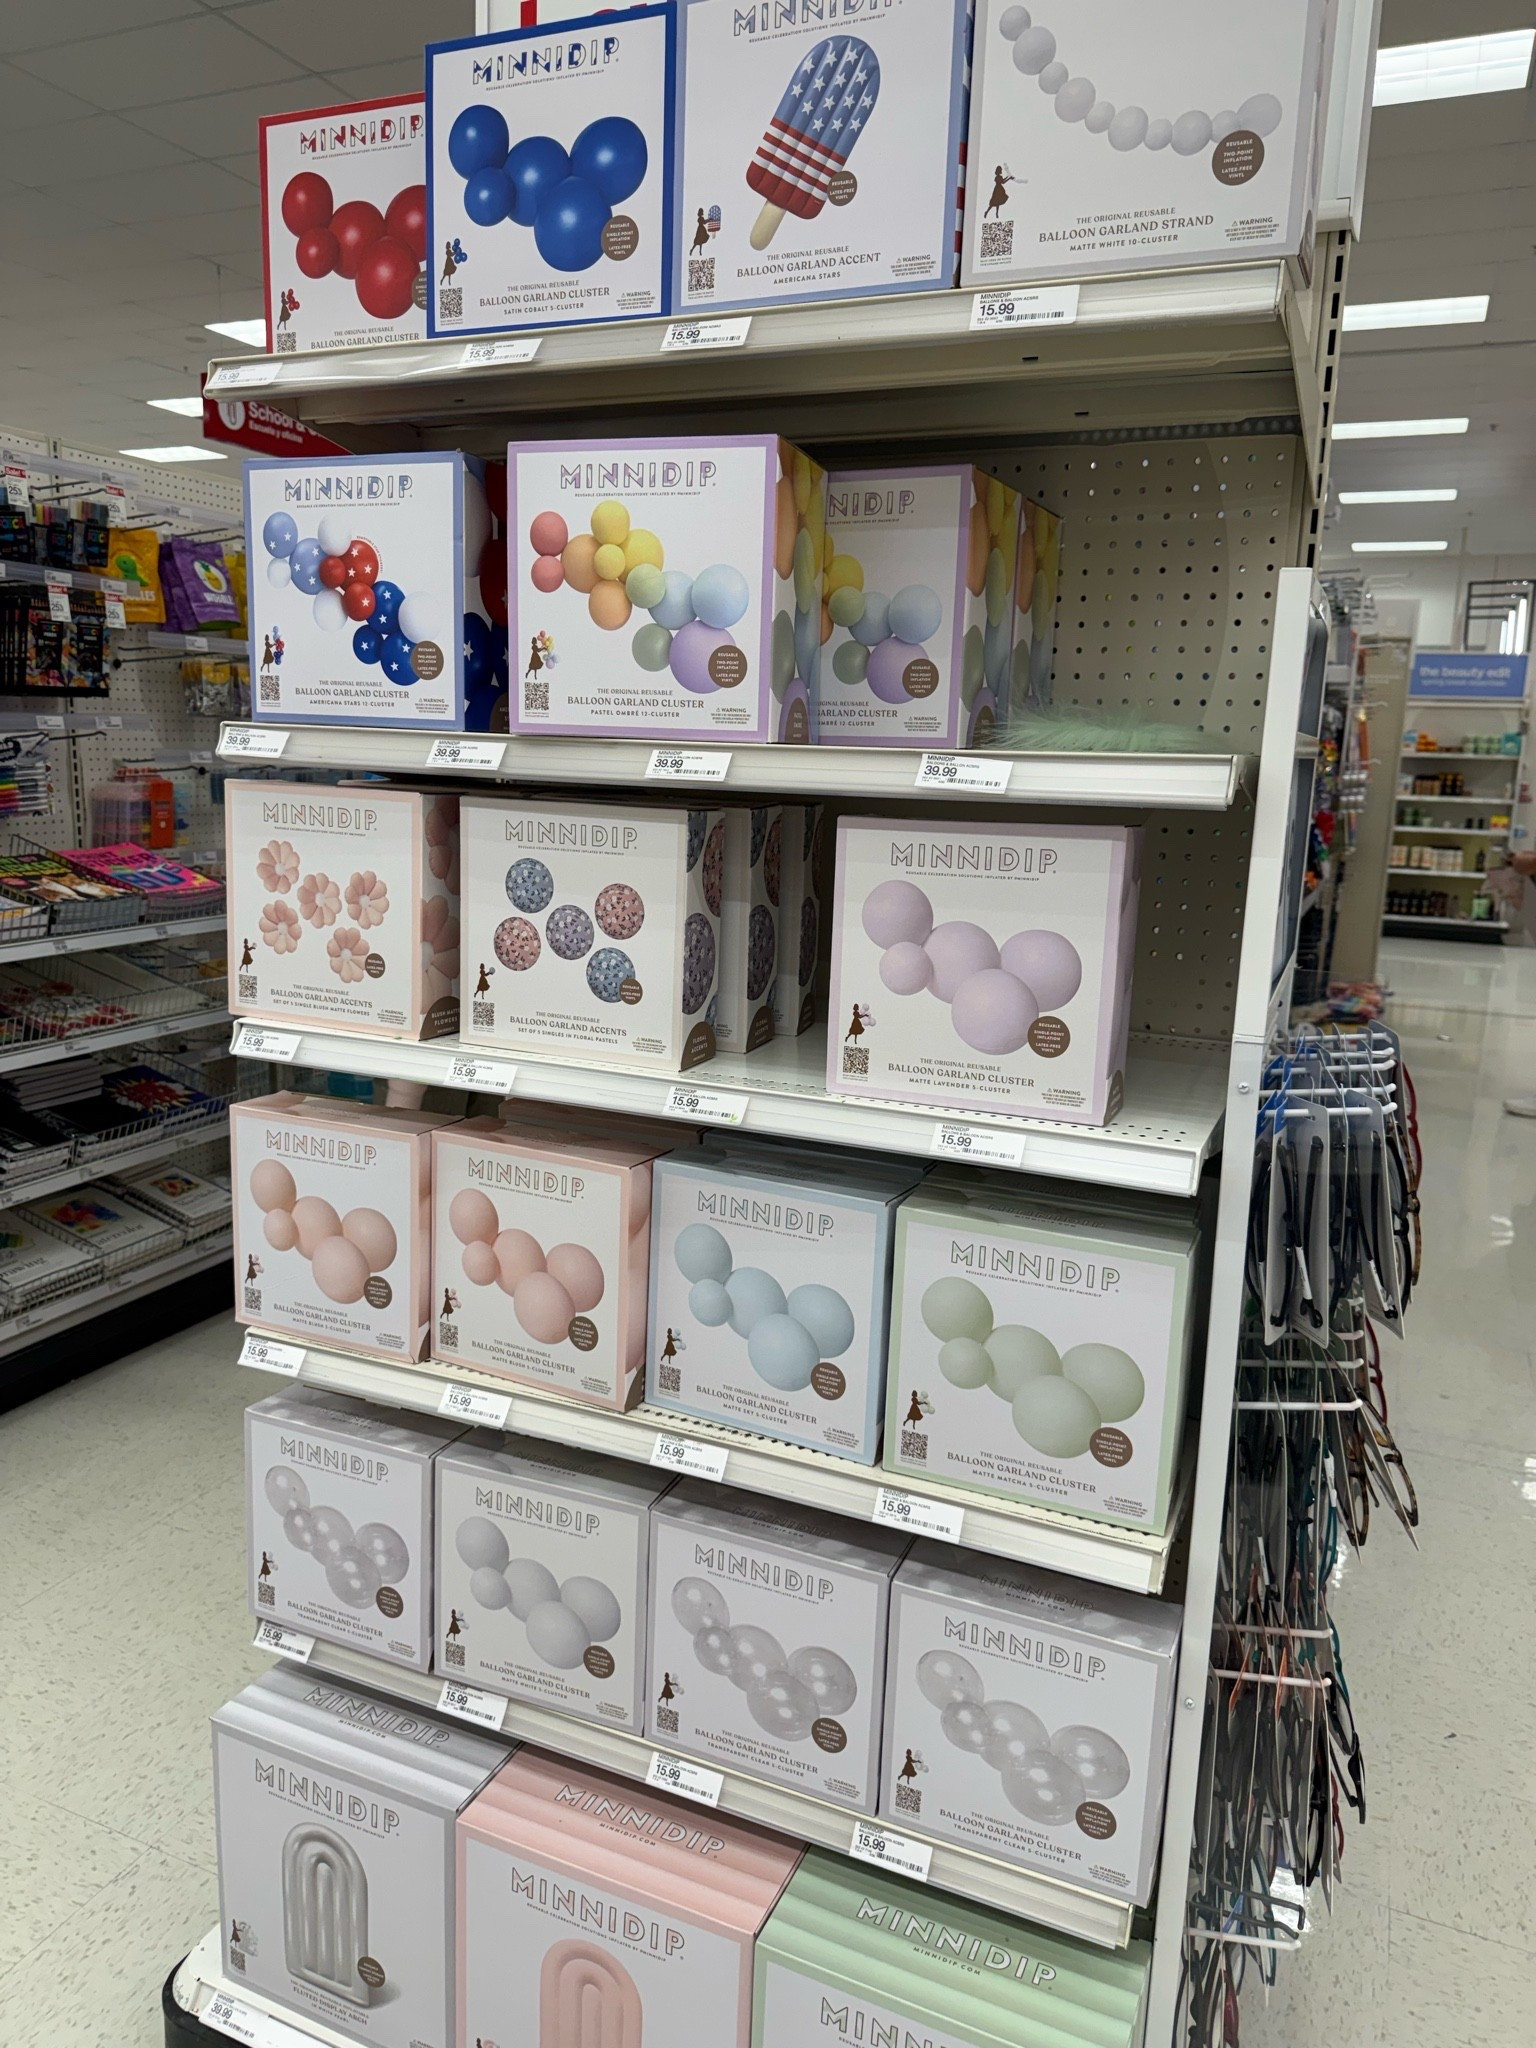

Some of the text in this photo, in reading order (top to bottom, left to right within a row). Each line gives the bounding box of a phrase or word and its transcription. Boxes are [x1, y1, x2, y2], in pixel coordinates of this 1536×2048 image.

[734, 0, 893, 36] MINNID
[472, 37, 619, 85] MINNIDIP
[299, 114, 423, 154] MINNIDIP
[1226, 139, 1253, 147] REUSABLE
[1223, 149, 1254, 157] TWO-POINT
[1223, 156, 1253, 164] INFLATION
[1221, 165, 1253, 174] LATEX-FREE
[1076, 207, 1175, 224] THE ORIGINAL REUSABLE
[1238, 216, 1273, 225] WARNING
[1038, 214, 1214, 242] BALLOON GARLAND STRAND
[1069, 233, 1178, 251] MATTE WHITE 10-CLUSTER
[736, 252, 879, 277] BALLOON GARLAND ACCENT
[901, 253, 931, 262] WARNING
[773, 271, 840, 284] AMERICANA STARS
[479, 286, 610, 306] BALLOON GARLAND CLUSTER
[980, 292, 1012, 300] MINNIDIP
[503, 302, 584, 315] SATIN COBALT 5-CLUSTER
[979, 303, 1015, 316] 15.99
[310, 332, 419, 349] BALLOON GARLAND CLUSTER
[670, 330, 700, 340] 15.99
[469, 348, 495, 359] 15.99
[559, 461, 716, 489] MINNIDIP
[284, 475, 412, 501] MINNIDIP
[829, 490, 915, 518] NIDIP
[294, 687, 409, 698] BALLOON GARLAND CLUSTER
[567, 695, 704, 708] BALLOON GARLAND CLUSTER
[858, 709, 898, 718] CLUSTER
[226, 735, 250, 745] 39.99
[434, 748, 460, 758] 39.99
[654, 758, 683, 768] 39.99
[924, 765, 957, 777] 39.99
[262, 802, 377, 830] MINNIDIP
[504, 820, 637, 848] MINNIDIP
[890, 842, 1057, 874] MINNIDIP
[269, 988, 372, 1008] BALLOON GARLAND ACCENTS
[509, 1015, 627, 1036] BALLOON GARLAND ACCENTS
[242, 1036, 264, 1047] 15.99
[541, 1029, 564, 1037] SINGLES
[572, 1033, 594, 1041] FLORAL
[594, 1036, 618, 1044] PASTELS
[452, 1066, 476, 1078] 15.99
[887, 1062, 1034, 1087] BALLOON GARLAND CLUSTER
[908, 1077, 1010, 1094] MATTE LAVENDER 5-CLUSTER
[1052, 1088, 1081, 1096] WARNING
[671, 1095, 699, 1108] 15.99
[265, 1129, 376, 1165] MINNIDIP
[940, 1134, 972, 1147] 15.99
[467, 1157, 584, 1198] MINNIDIP
[697, 1190, 834, 1237] MINNIDIP
[950, 1240, 1120, 1291] MINNIDIP
[273, 1303, 371, 1331] BALLOON GARLAND CLUSTER
[246, 1345, 268, 1358] 15.99
[470, 1340, 575, 1373] BALLOON GARLAND CLUSTER
[447, 1394, 472, 1407] 15.99
[695, 1385, 817, 1424] BALLOON GARLAND CLUSTER
[722, 1402, 741, 1412] MATTE
[755, 1411, 787, 1424] 5-CLUSTER
[279, 1436, 388, 1482] MINNIDIP
[658, 1444, 685, 1459] 15.99
[946, 1452, 1096, 1492] BALLOON GARLAND CLUSTER
[971, 1468, 1068, 1495] MATTE MATCHA 5-CLUSTER
[475, 1487, 600, 1534] MINNIDIP
[881, 1500, 911, 1516] 15.99
[694, 1543, 833, 1599] MINNIDIP
[286, 1600, 383, 1637] BALLOON GARLAND CLUSTER
[262, 1627, 283, 1641] 15.99
[943, 1615, 1105, 1678] MINNIDIP
[479, 1660, 590, 1698] BALLOON GARLAND CLUSTER
[445, 1690, 468, 1705] 15.99
[303, 1686, 450, 1745] MINNIDIP
[694, 1728, 818, 1773] BALLOON GARLAND CLUSTER
[655, 1764, 681, 1780] 15.99
[254, 1758, 399, 1833] MINNIDIP
[554, 1785, 725, 1856] MINNIDIP
[598, 1822, 656, 1846] MINNIDIP.COM
[857, 1834, 886, 1851] 15.99
[939, 1808, 1081, 1860] BALLOON GARLAND CLUSTER
[953, 1823, 1065, 1863] TRANSPARENT CLEAR 5-CLUSTER
[510, 1866, 685, 1955] MINNIDIP
[855, 1897, 1056, 1986] MINNIDIP
[912, 1946, 980, 1975] MINNIDIP.COM
[210, 2002, 233, 2019] 39.99
